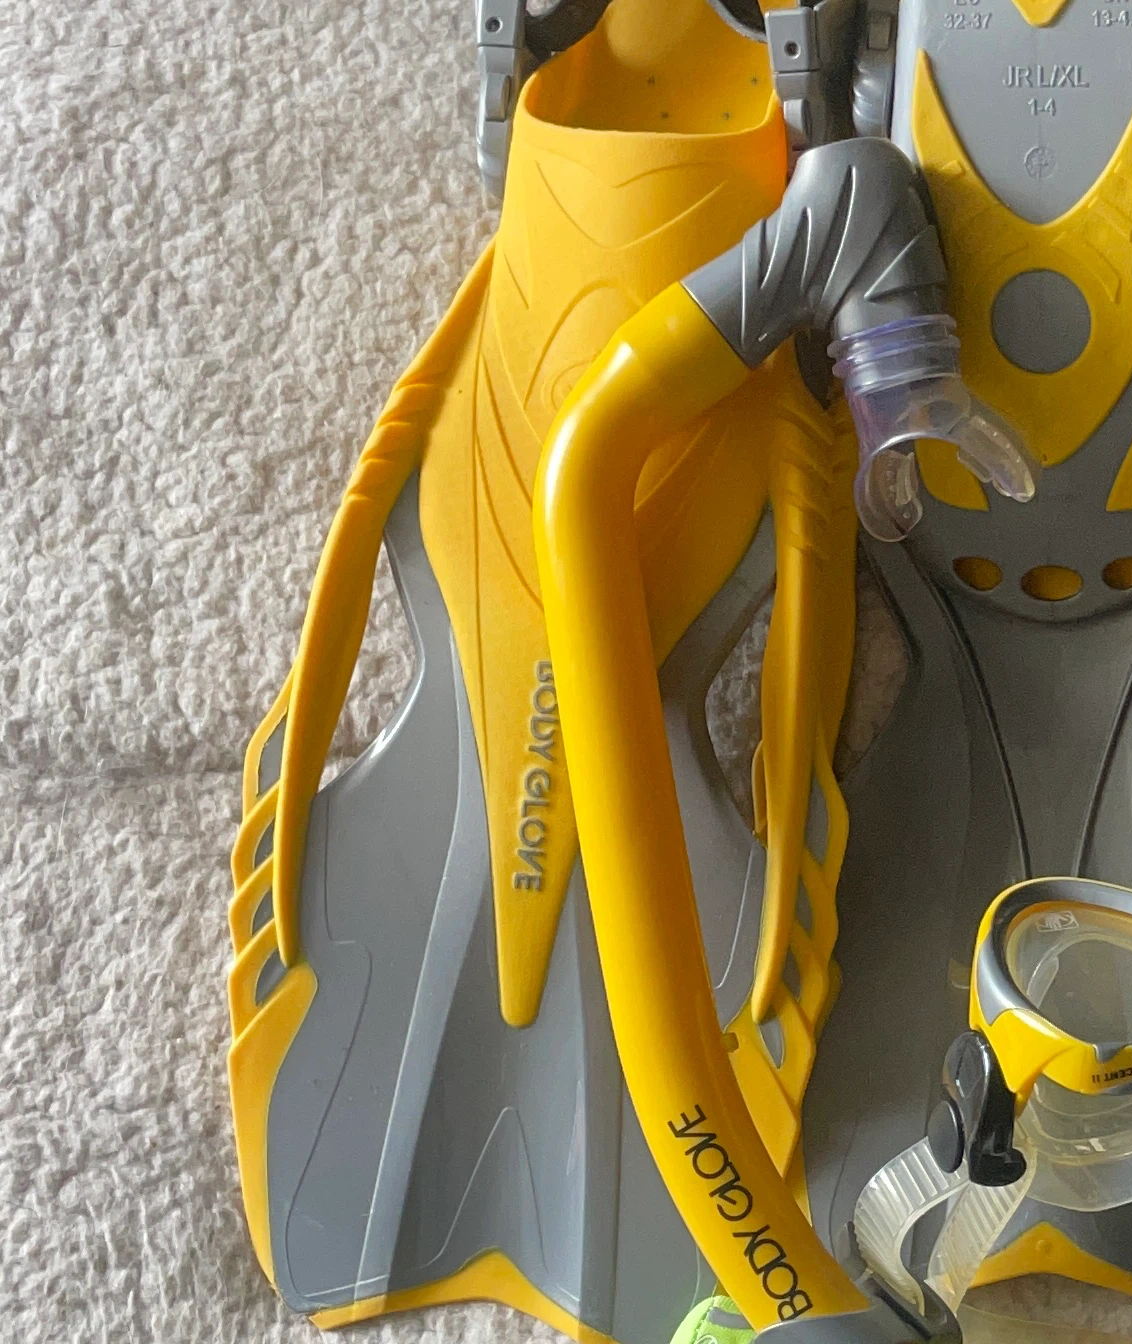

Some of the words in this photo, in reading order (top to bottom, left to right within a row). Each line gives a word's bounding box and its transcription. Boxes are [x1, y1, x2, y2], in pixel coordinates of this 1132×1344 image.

[1002, 65, 1034, 88] JR
[1036, 64, 1090, 88] L/XL
[1027, 98, 1056, 116] 1-4
[514, 768, 551, 892] GLOVE
[667, 1104, 753, 1222] GLOVE
[732, 1224, 813, 1322] BODY
